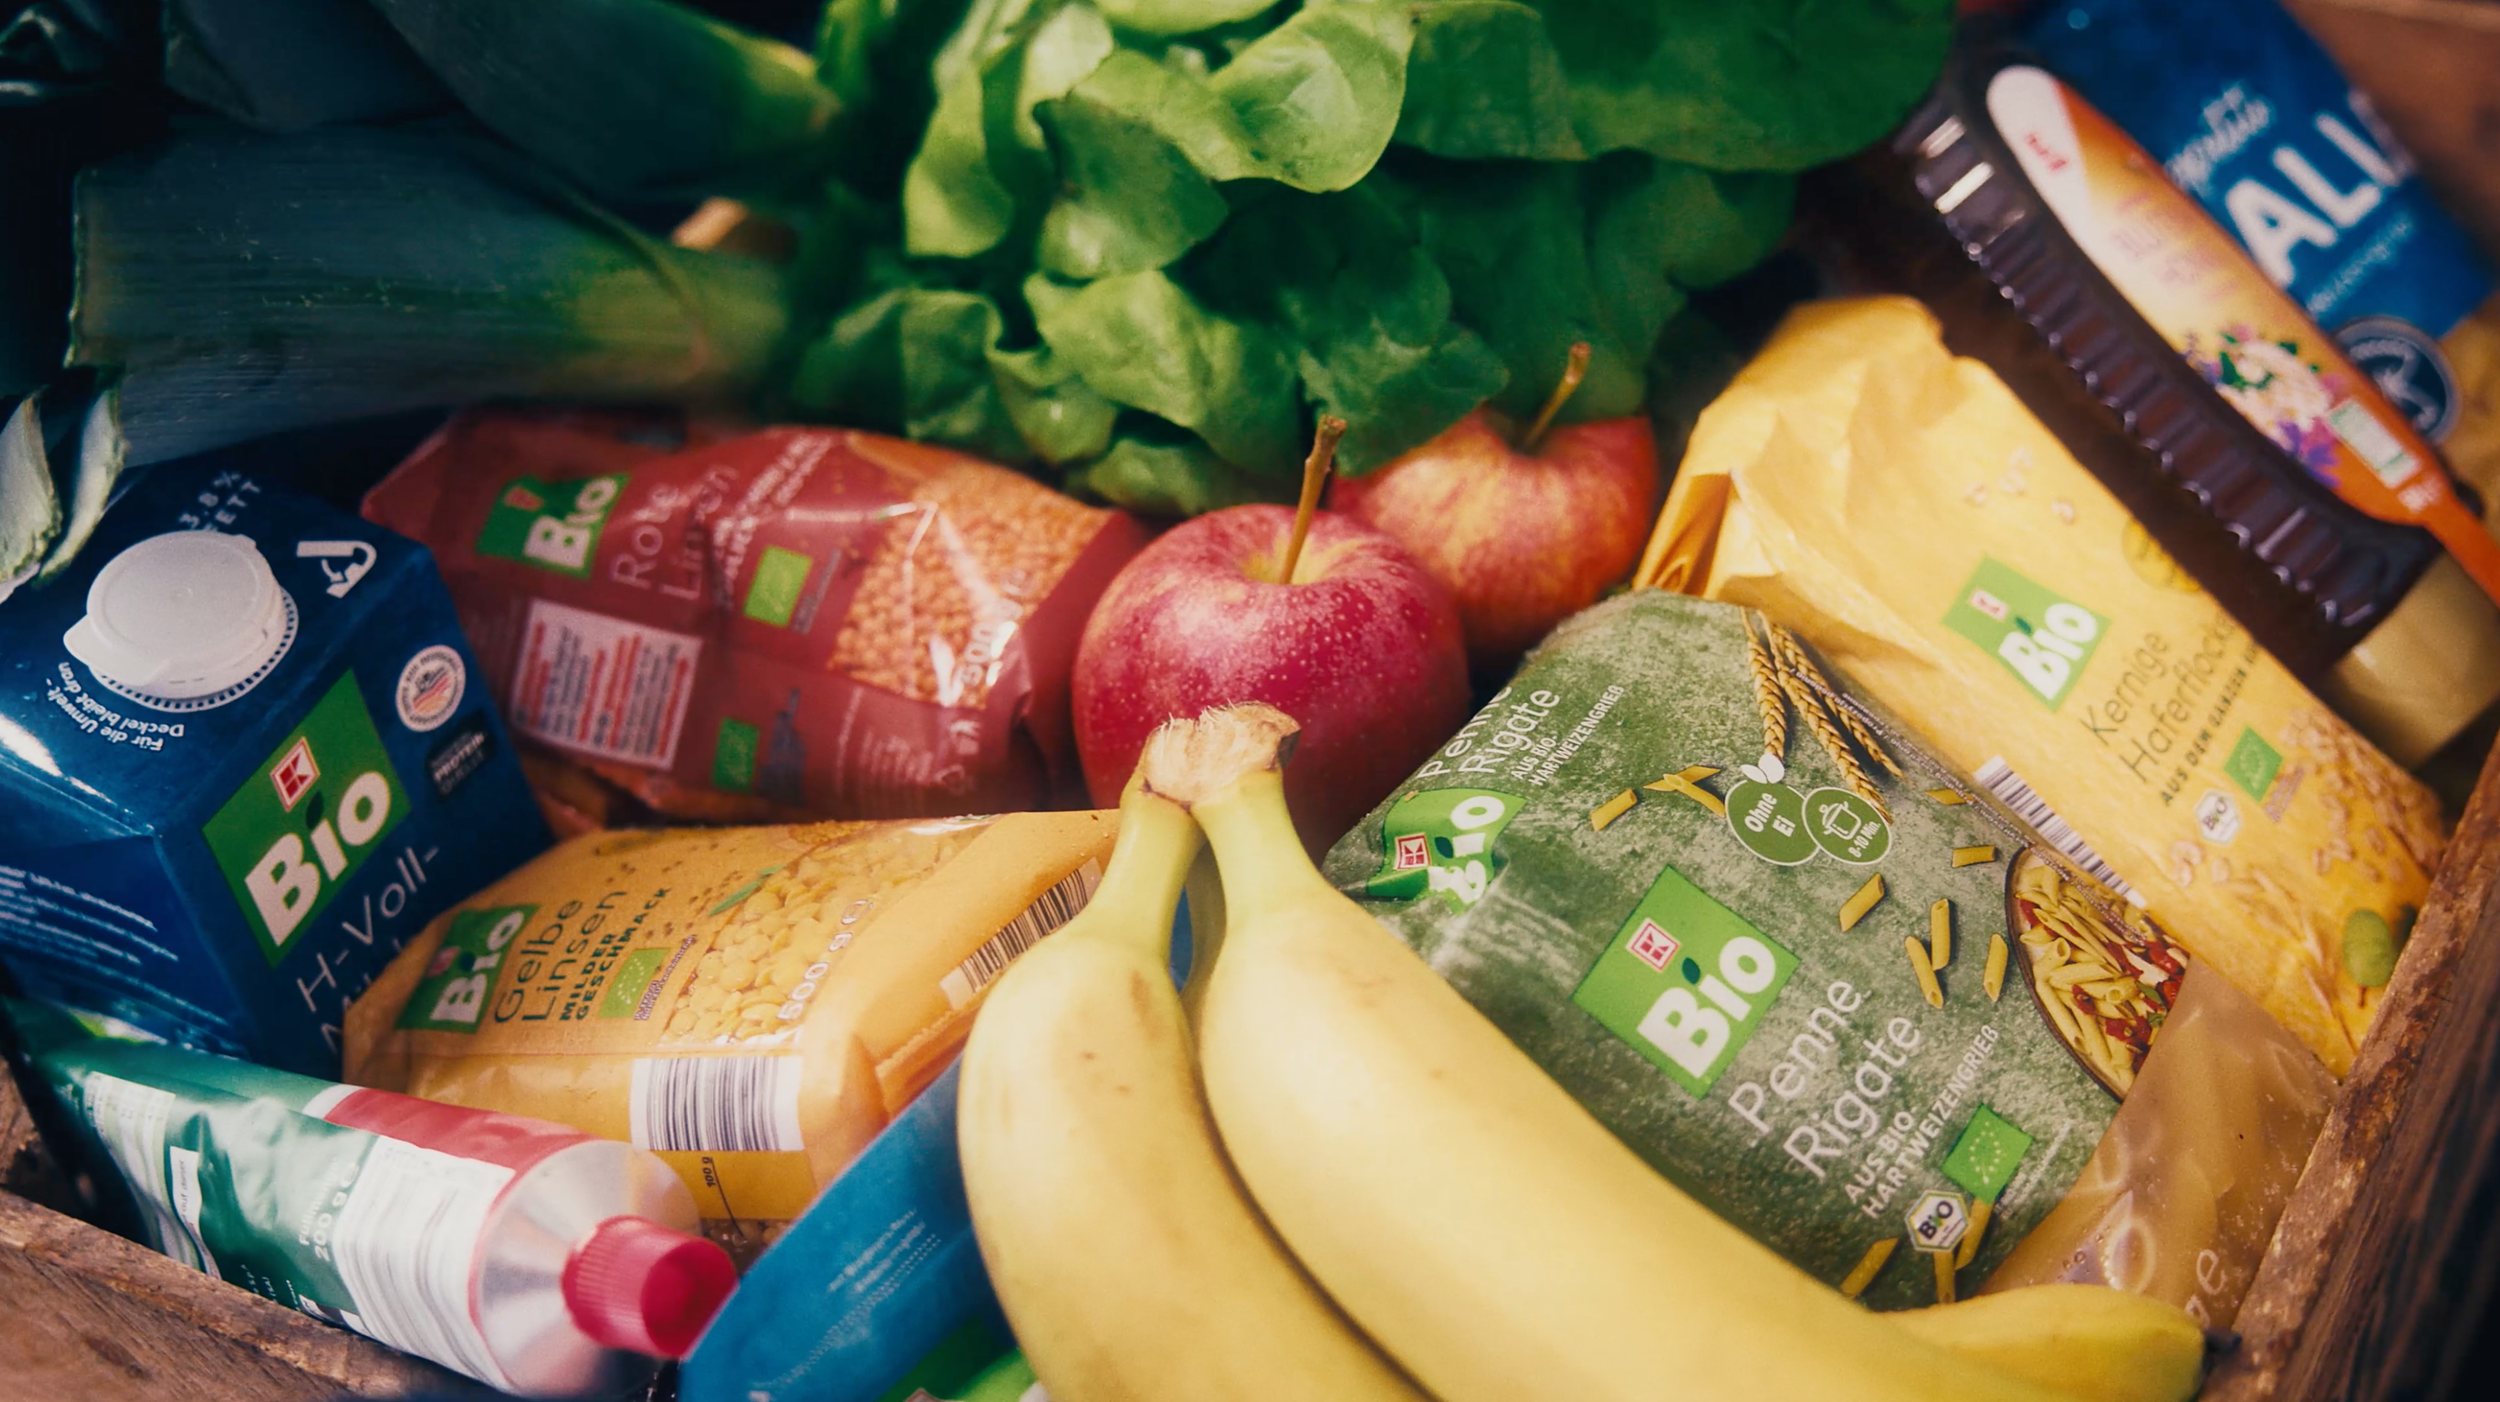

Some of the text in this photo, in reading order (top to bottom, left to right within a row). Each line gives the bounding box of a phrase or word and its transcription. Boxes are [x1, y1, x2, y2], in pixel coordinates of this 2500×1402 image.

[58, 662, 82, 694] dran
[2079, 632, 2168, 745] Kernige
[100, 725, 128, 744] die
[119, 718, 185, 737] Deckel
[131, 735, 164, 752] Für
[1458, 690, 1561, 775] Rigate
[1511, 755, 1540, 781] AUS
[1744, 792, 1778, 832] Ohne
[1772, 815, 1796, 837] Ei
[244, 771, 391, 947] Bio
[494, 900, 583, 1023] Gelbe
[521, 891, 627, 1021] Linsen
[560, 933, 616, 1021] MILDER
[776, 961, 829, 1021] 500
[1636, 936, 1776, 1079] Bio
[1728, 980, 1864, 1134] Penne
[1783, 1016, 1921, 1179] Rigate
[702, 1165, 716, 1189] 100
[1844, 1152, 1885, 1203] AUS
